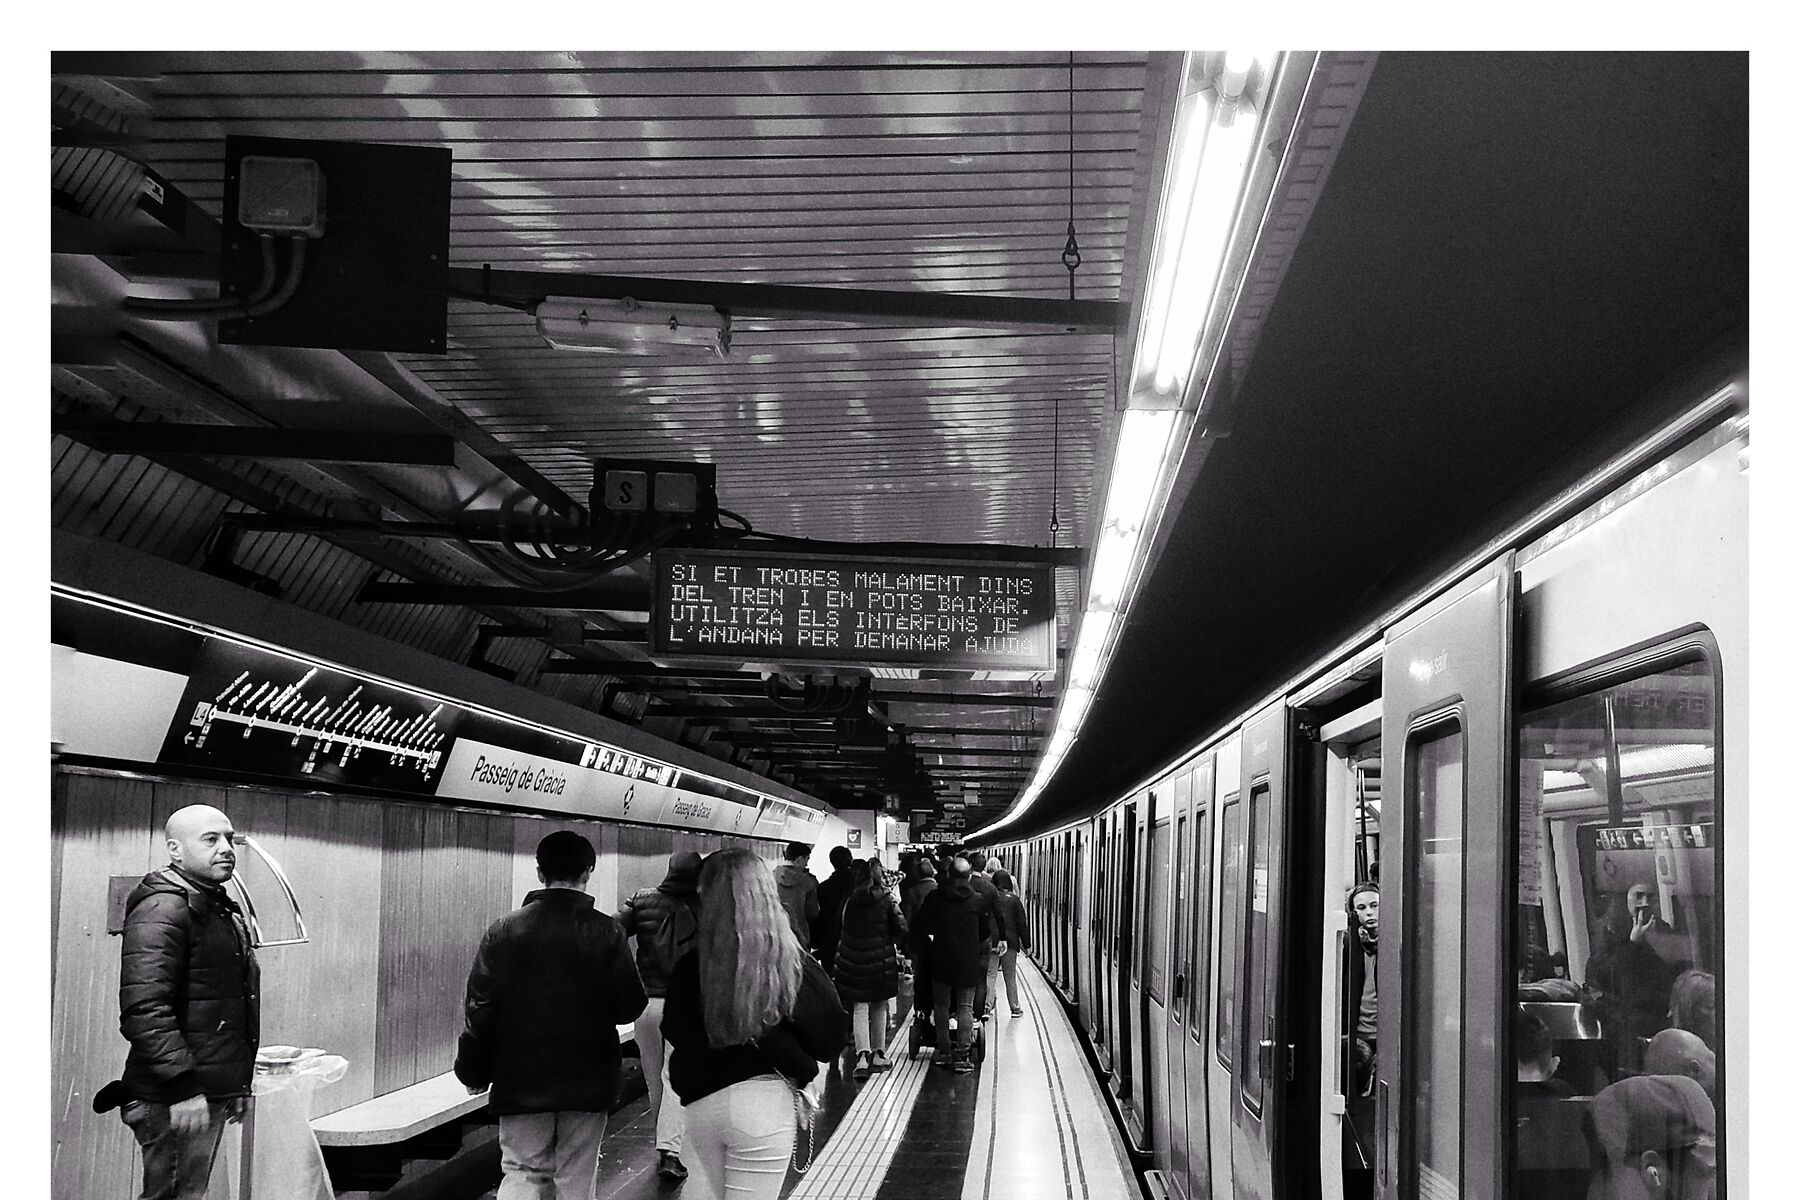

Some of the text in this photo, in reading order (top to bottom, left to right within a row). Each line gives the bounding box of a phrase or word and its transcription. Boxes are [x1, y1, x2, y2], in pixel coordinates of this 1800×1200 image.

[671, 563, 1033, 595] SI ET TROBES MALAMENT DINS
[671, 584, 1029, 616] DEL TREN I EN POTS BAIXAR.
[670, 604, 784, 626] UTILITZA
[798, 609, 840, 628] ELS
[993, 616, 1020, 634] DE
[669, 624, 1034, 656] L'ANDANA PER DEMANAR AJUDA
[470, 755, 519, 794] Passeig
[517, 765, 534, 790] de
